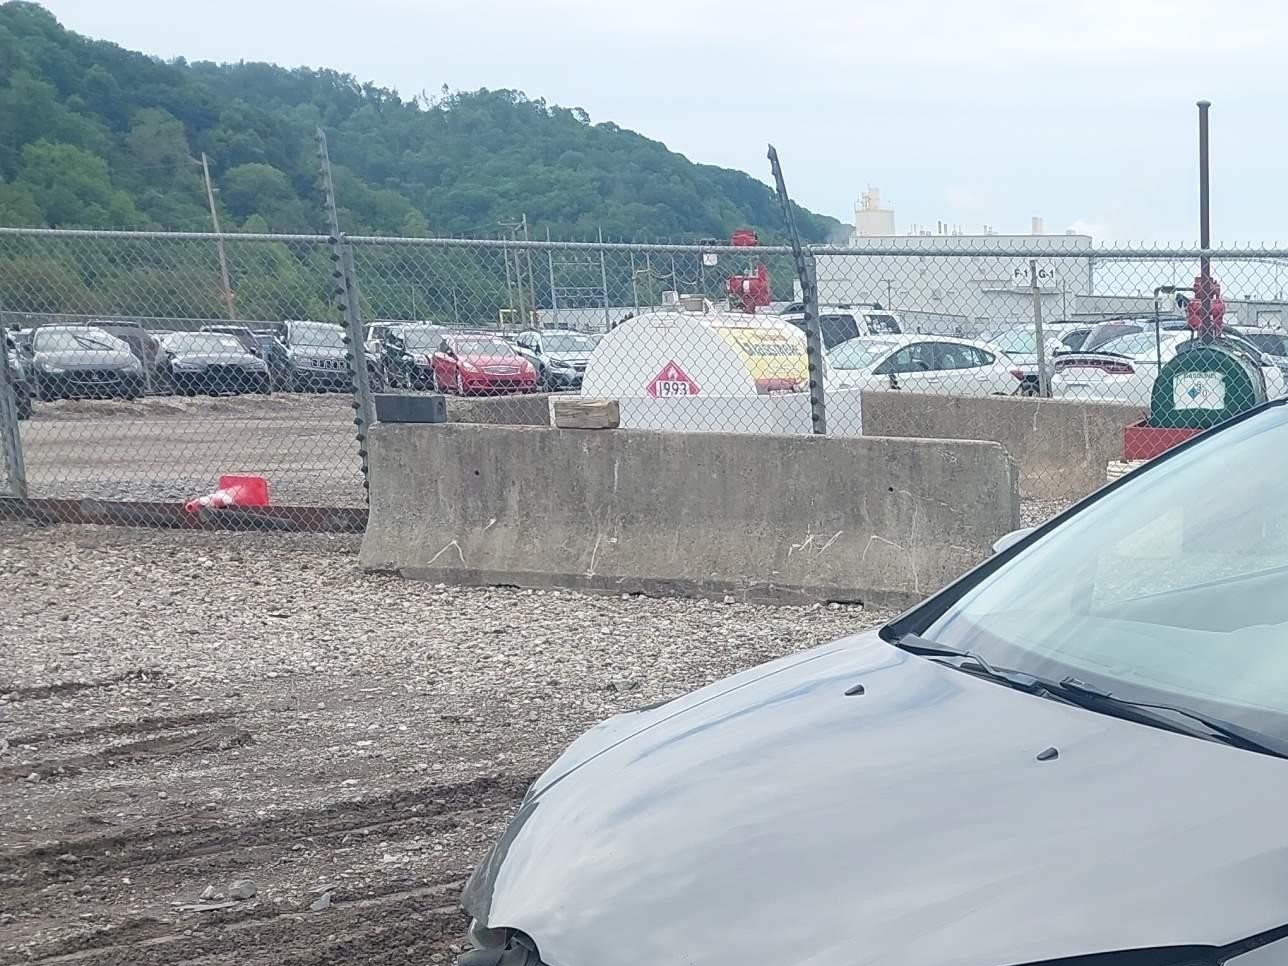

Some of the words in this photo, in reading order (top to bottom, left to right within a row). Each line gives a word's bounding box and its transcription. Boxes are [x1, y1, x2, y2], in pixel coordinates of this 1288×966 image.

[1014, 269, 1028, 278] F-1
[1038, 269, 1054, 279] G-1
[659, 382, 687, 396] 1993
